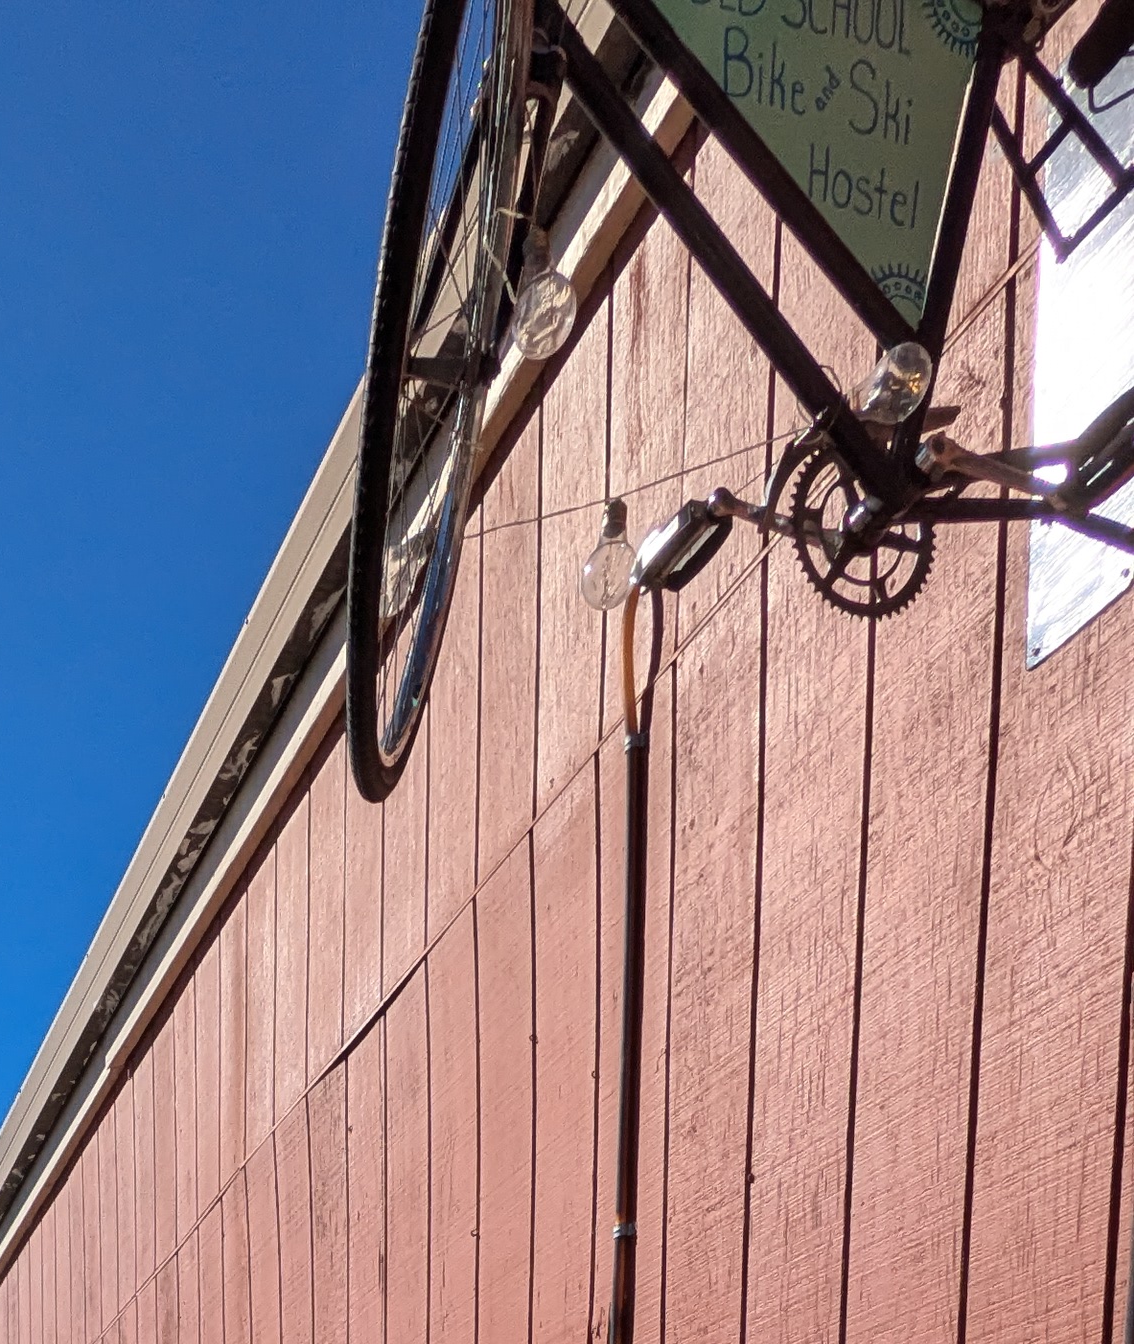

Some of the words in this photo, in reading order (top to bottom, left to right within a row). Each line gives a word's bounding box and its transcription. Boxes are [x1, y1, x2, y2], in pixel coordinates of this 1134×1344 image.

[723, 25, 806, 116] Bike
[815, 65, 842, 112] and
[848, 59, 911, 146] Ski
[807, 143, 919, 229] Hostel
